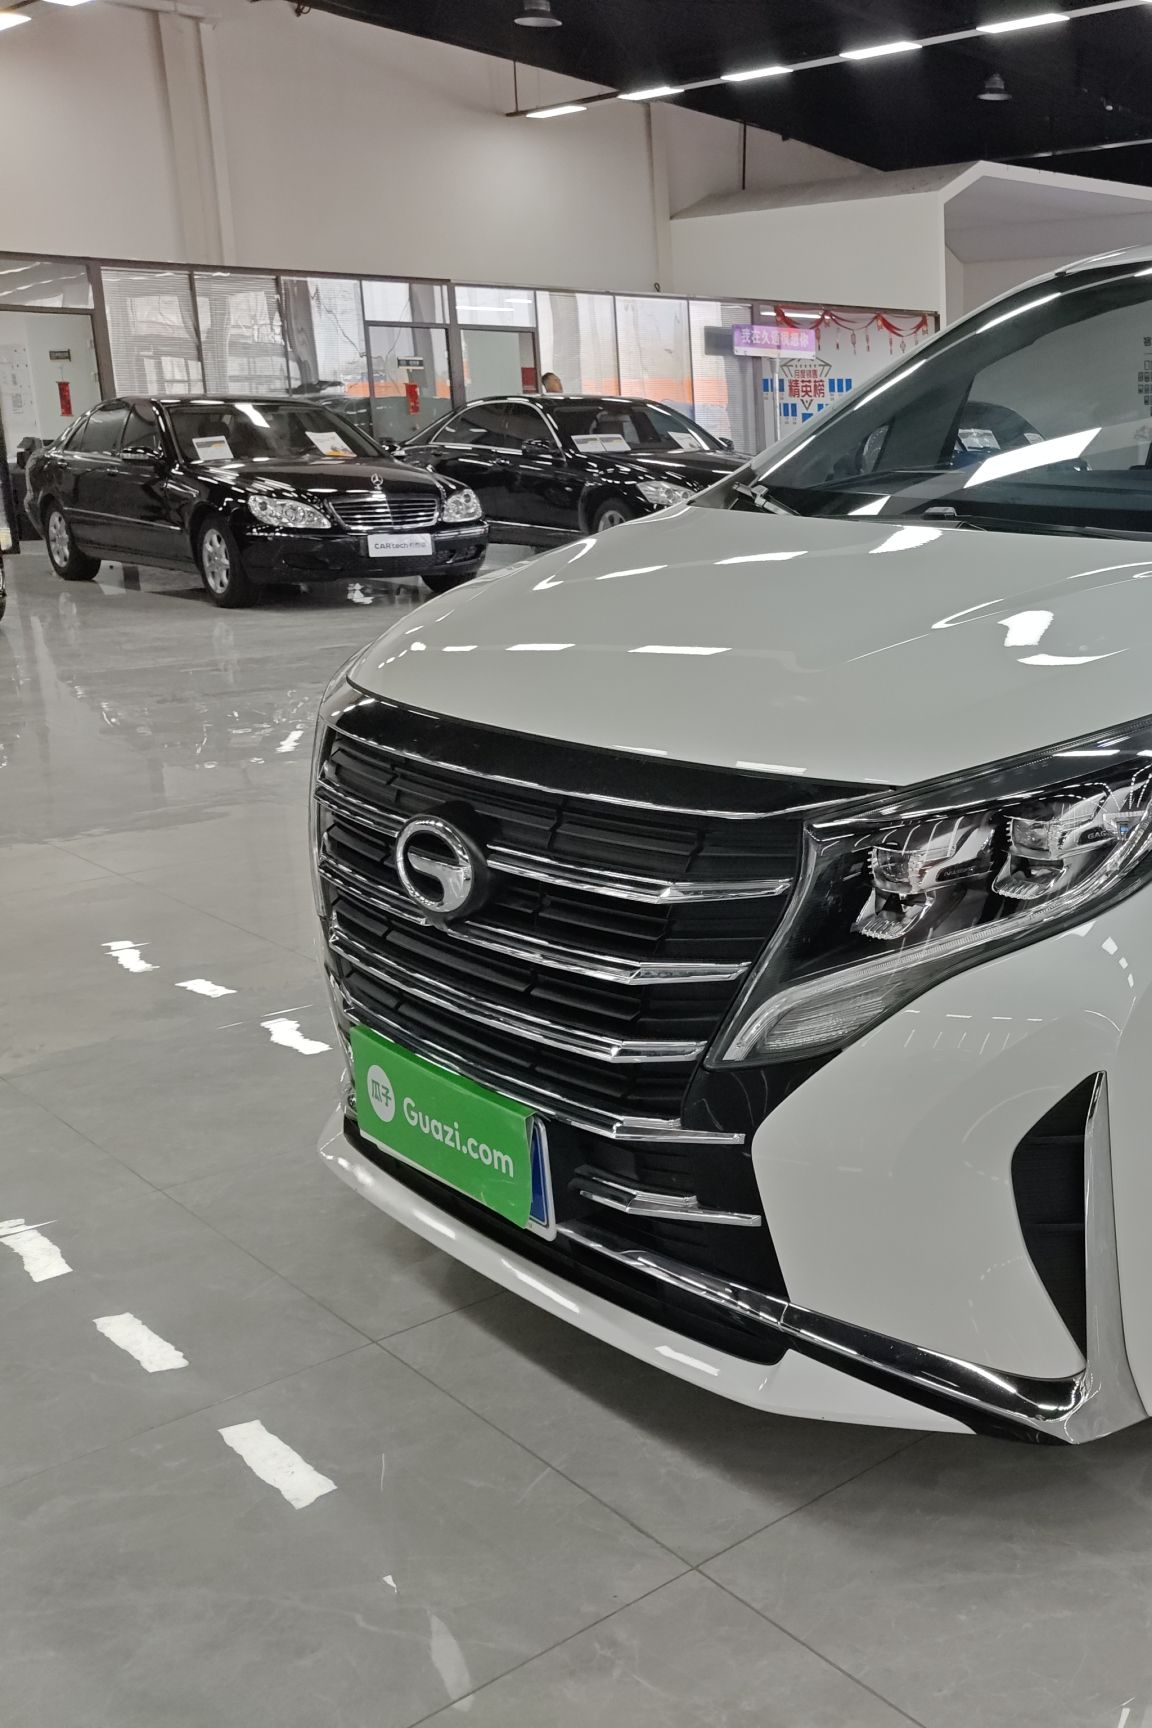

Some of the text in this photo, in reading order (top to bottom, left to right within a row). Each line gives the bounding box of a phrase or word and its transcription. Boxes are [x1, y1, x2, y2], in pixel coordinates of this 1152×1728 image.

[788, 379, 825, 398] 精英榜
[371, 1079, 392, 1108] 瓜子
[403, 1096, 514, 1179] Guazi.com
